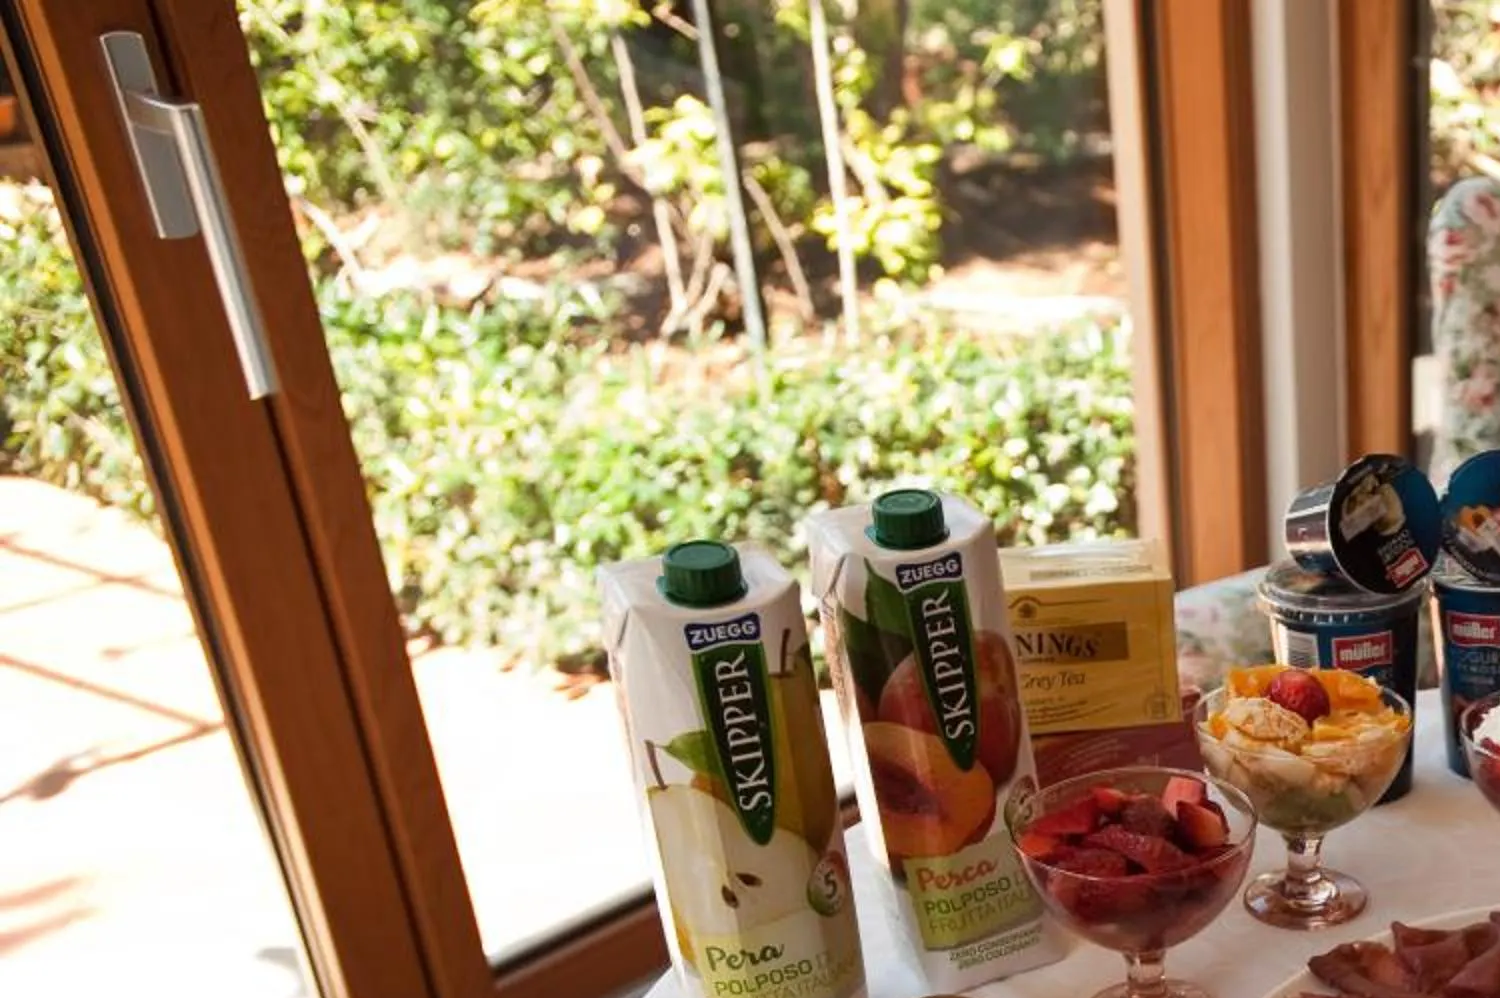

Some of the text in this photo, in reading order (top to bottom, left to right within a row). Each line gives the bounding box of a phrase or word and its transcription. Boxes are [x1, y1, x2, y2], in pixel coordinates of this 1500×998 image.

[900, 559, 959, 583] ZUEGG
[689, 621, 757, 644] ZUEGG
[1014, 631, 1100, 659] NINGS
[922, 588, 975, 739] SKIPPER
[715, 651, 772, 810] SKIPPER
[823, 871, 838, 898] 5
[916, 858, 999, 892] Pesca
[924, 877, 1011, 916] POLPOSO
[705, 943, 785, 972] Pera
[713, 959, 813, 996] POLPOSO
